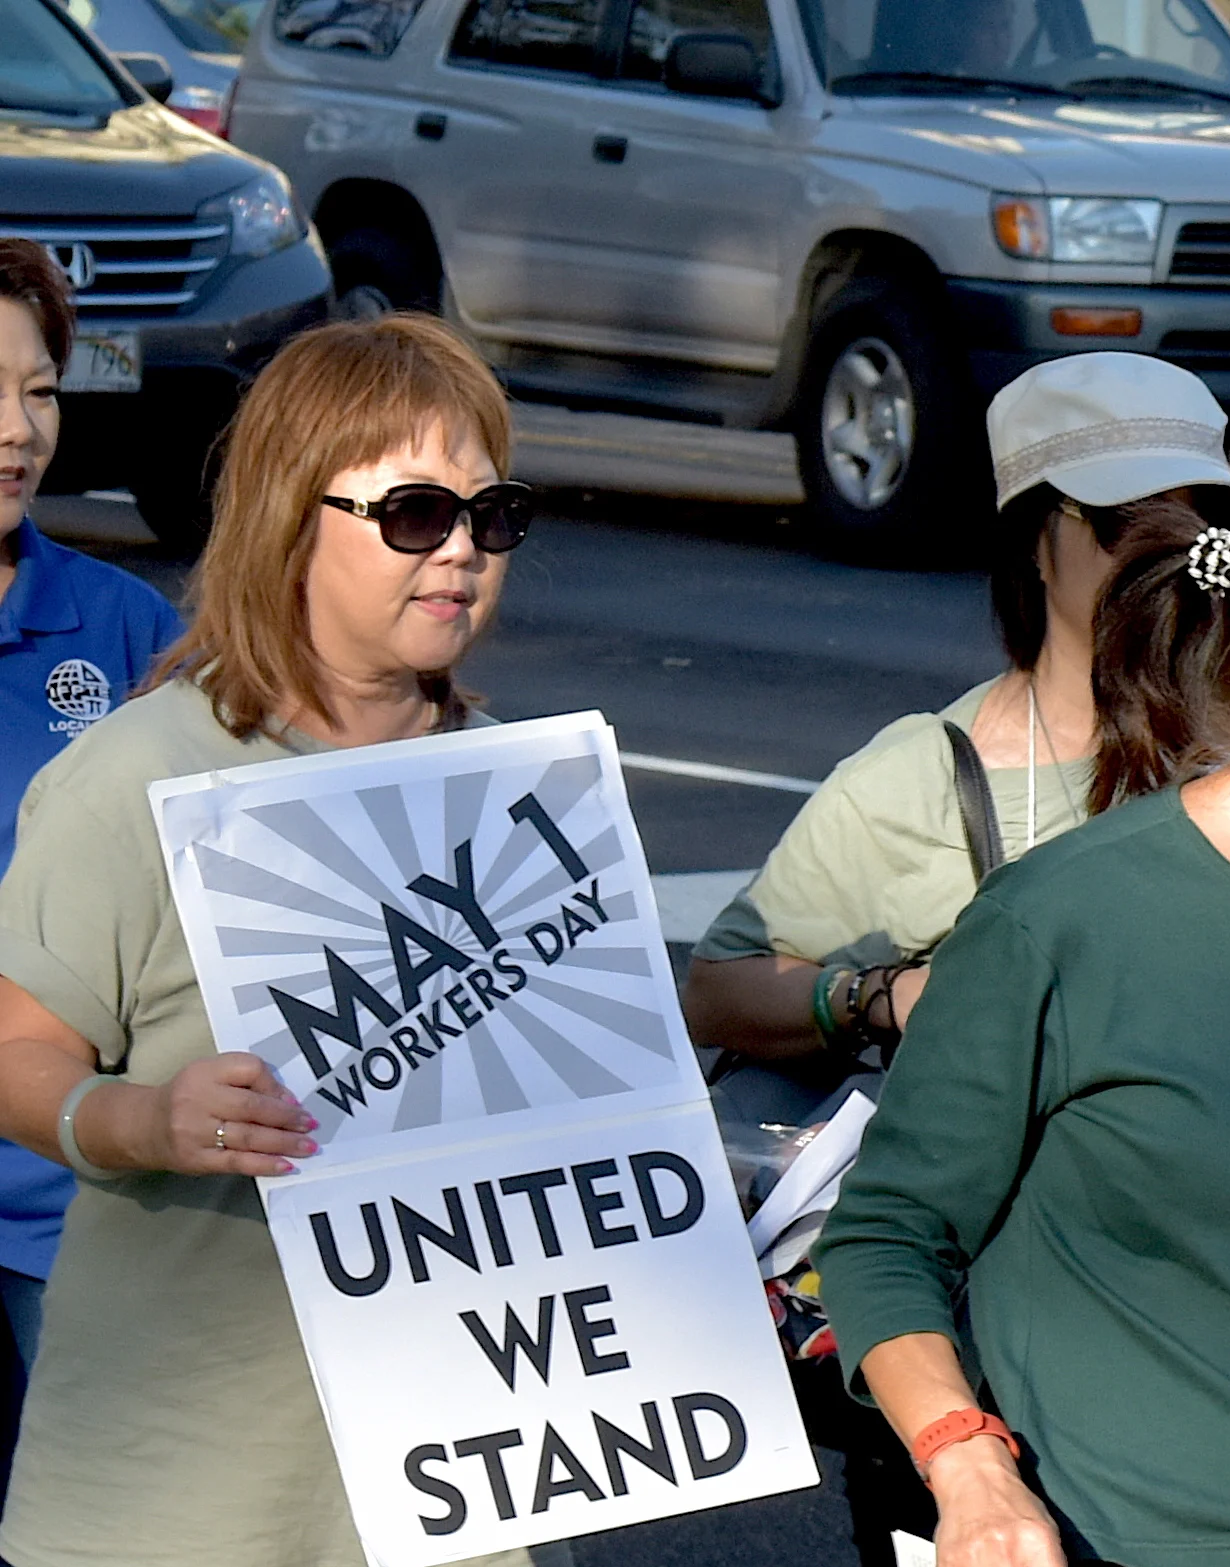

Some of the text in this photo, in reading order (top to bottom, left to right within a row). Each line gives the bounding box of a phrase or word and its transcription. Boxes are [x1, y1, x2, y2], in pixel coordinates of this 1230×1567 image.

[90, 344, 133, 376] 796
[266, 791, 591, 1081] MAY 1
[315, 878, 610, 1118] WORKERS DAY
[308, 1150, 705, 1297] UNITED
[458, 1284, 631, 1392] WE
[404, 1392, 747, 1536] STAND
